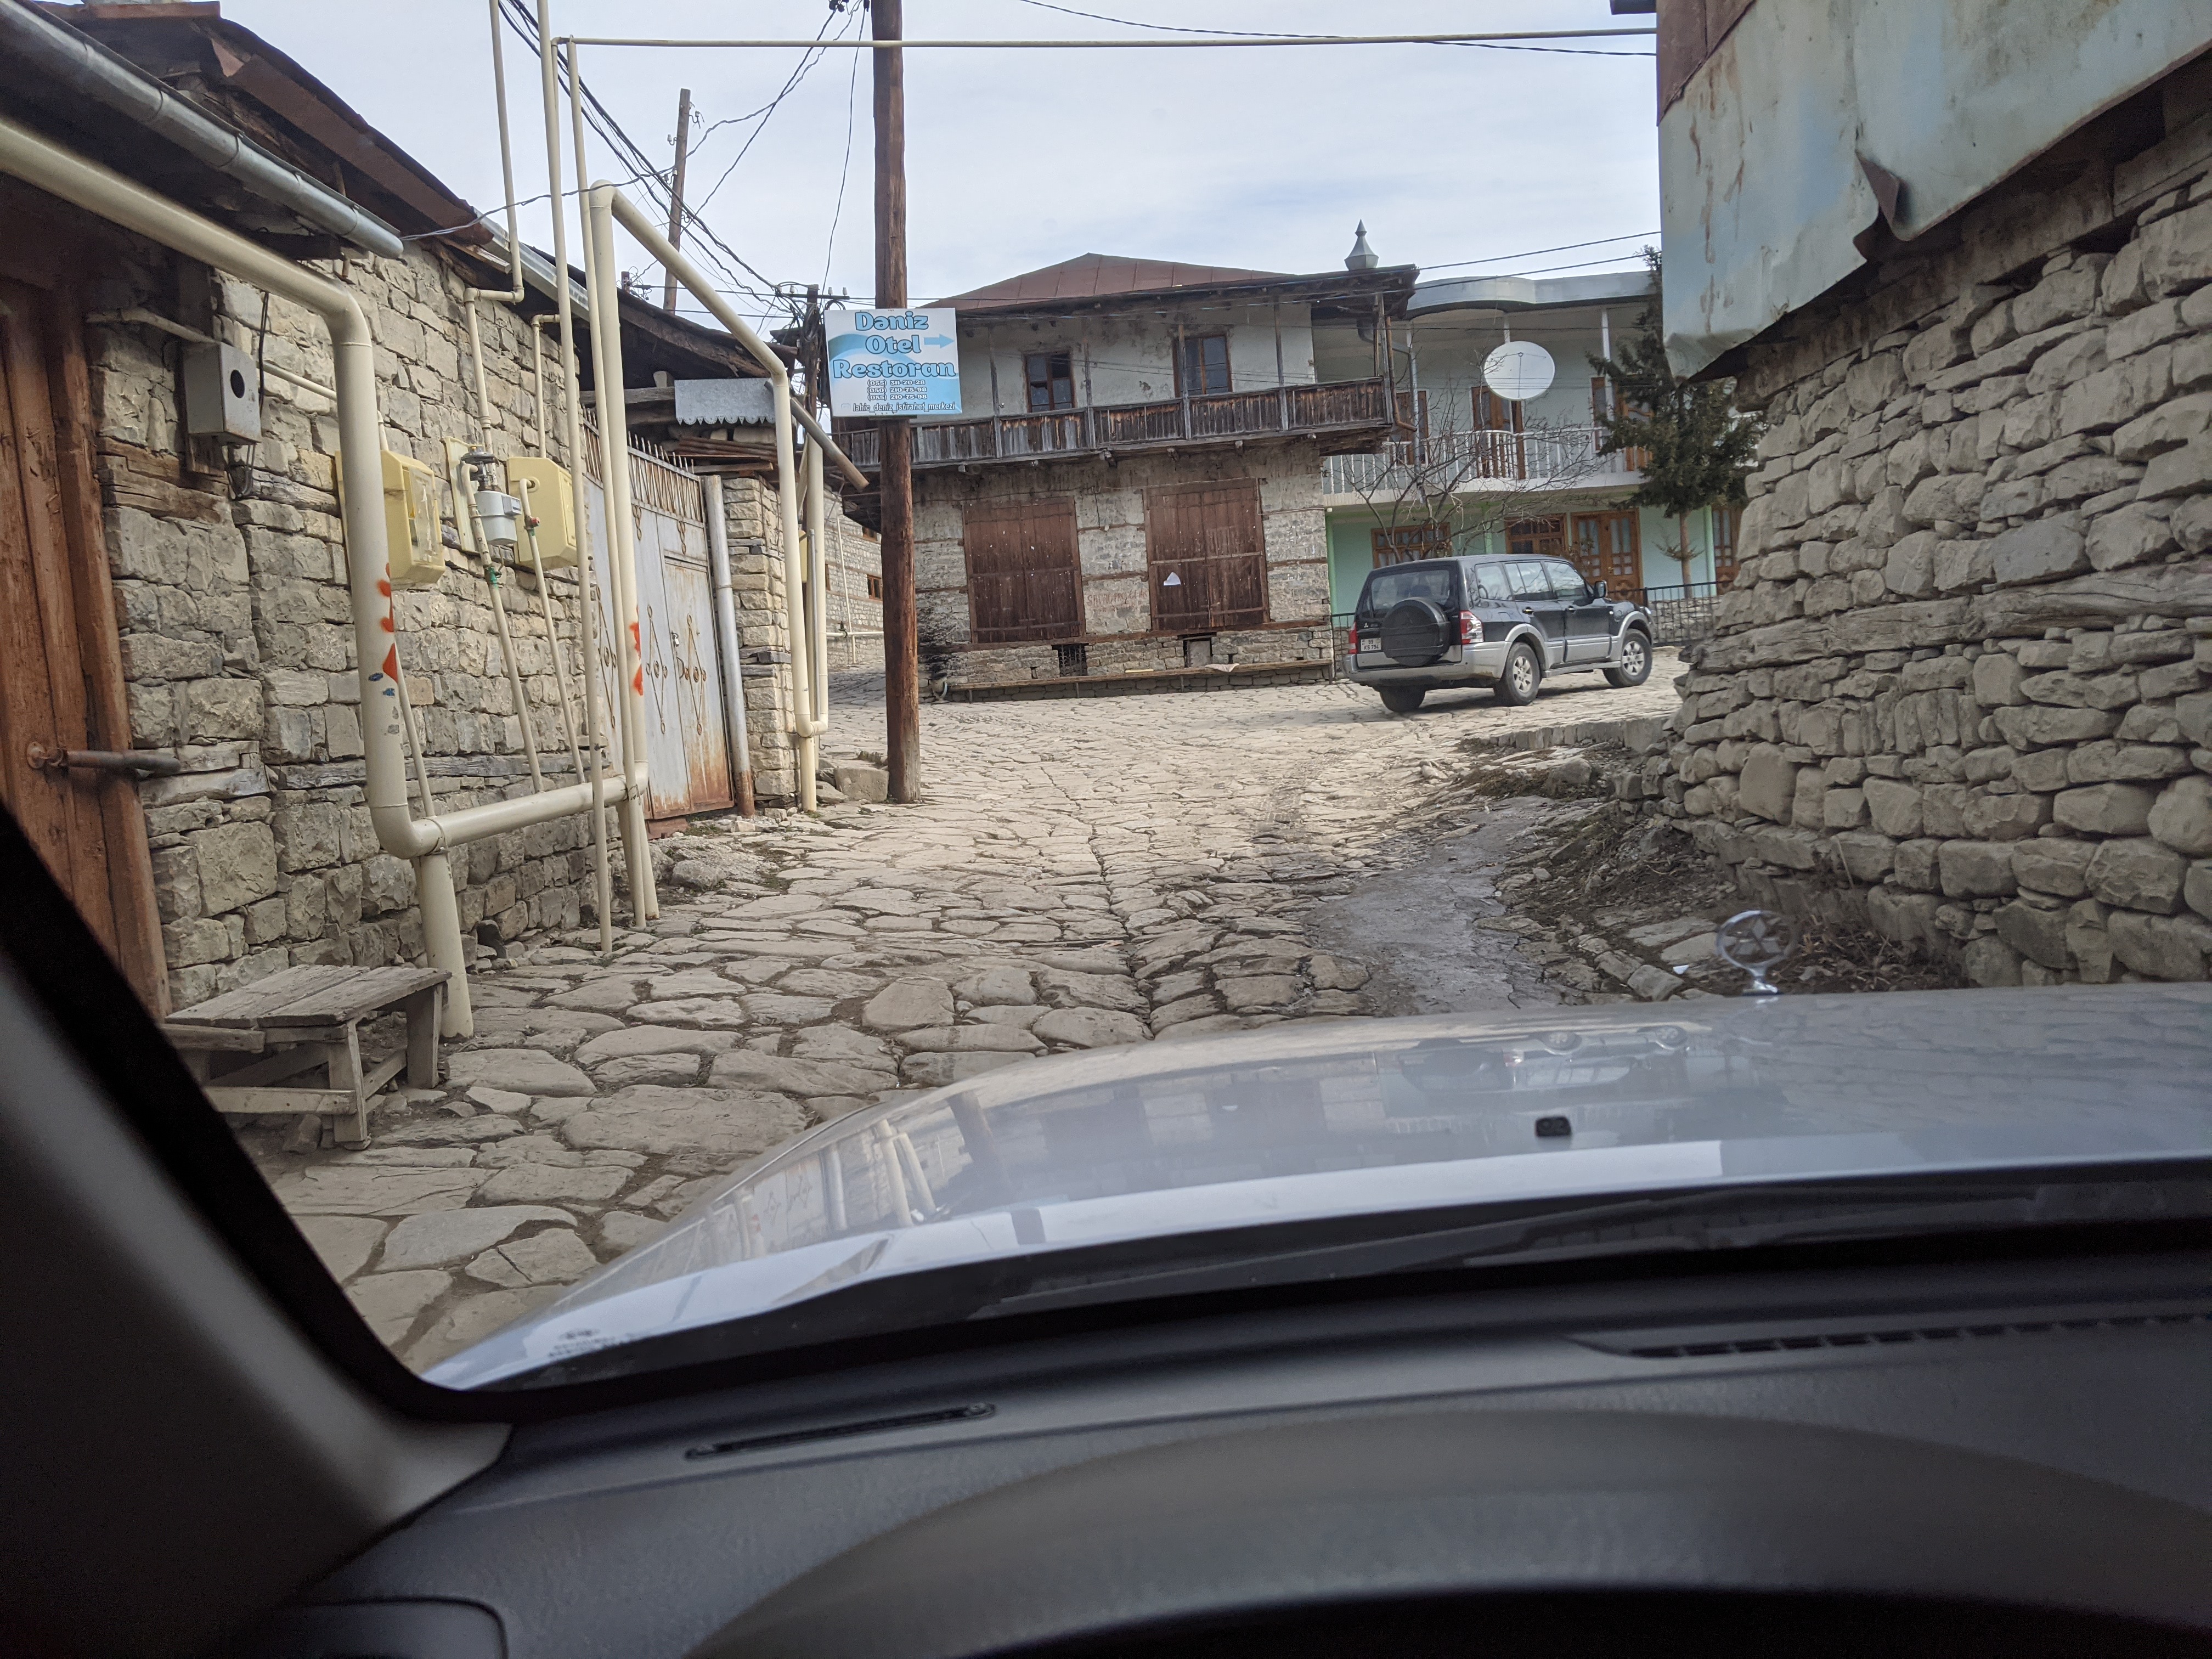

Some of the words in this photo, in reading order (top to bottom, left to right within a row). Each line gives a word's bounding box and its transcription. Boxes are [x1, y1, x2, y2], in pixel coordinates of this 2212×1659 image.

[854, 311, 929, 331] Dəniz
[865, 334, 922, 354] Otel
[832, 359, 956, 379] Restoran
[853, 402, 956, 414] lahic_deniz_istirahet_merkezi
